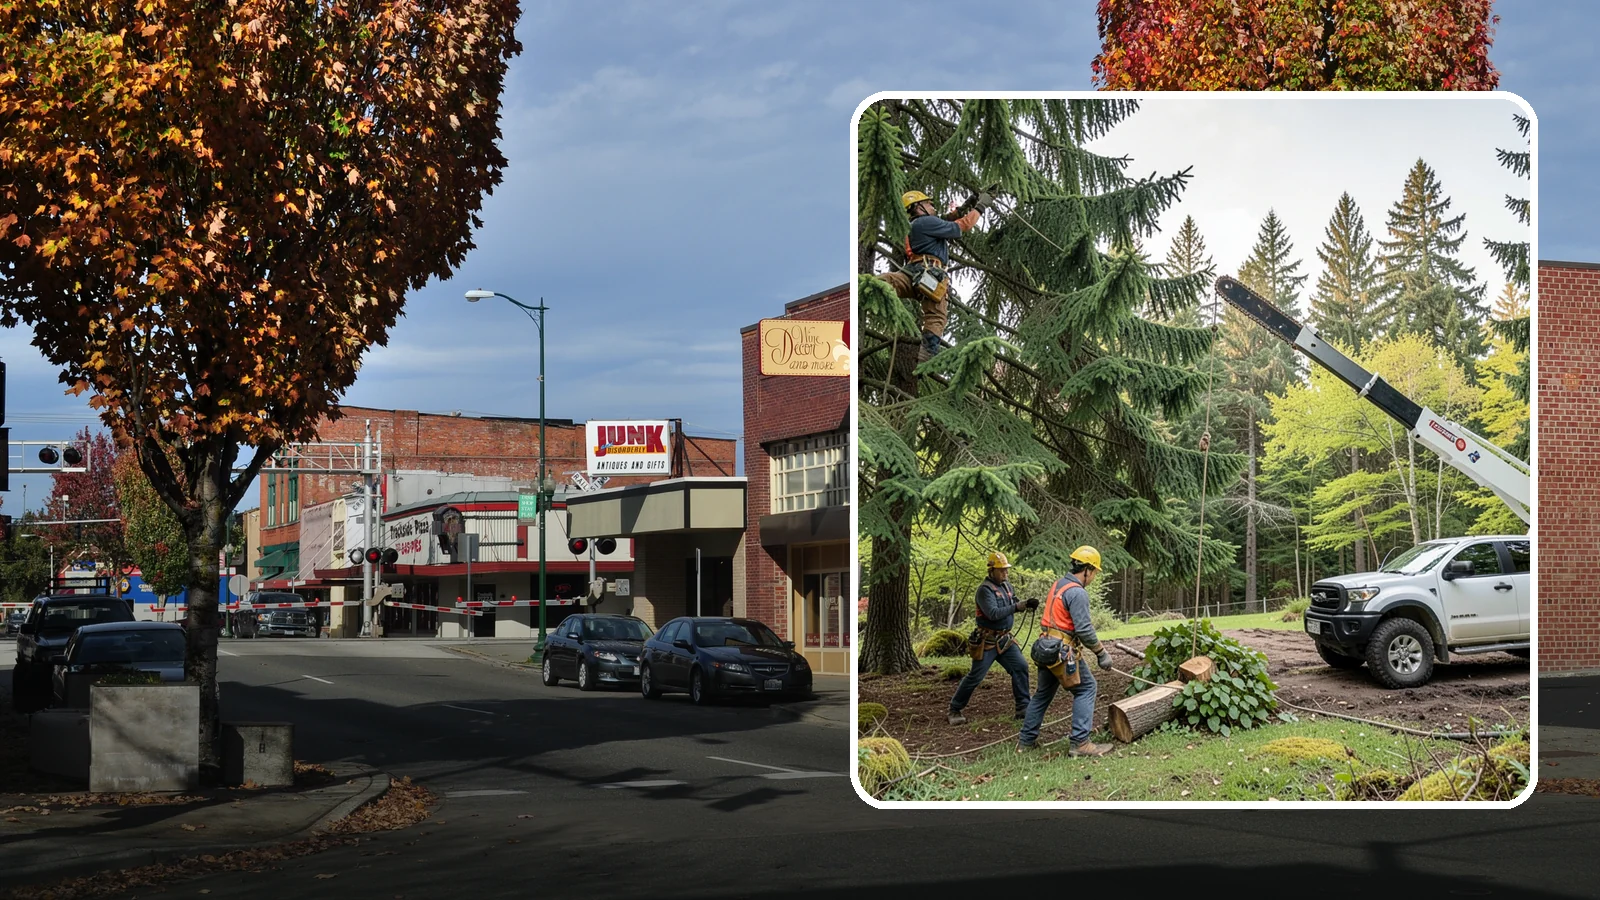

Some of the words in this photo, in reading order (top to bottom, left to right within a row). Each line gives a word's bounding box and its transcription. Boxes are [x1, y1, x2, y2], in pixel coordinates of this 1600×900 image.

[595, 425, 665, 457] JUNK
[607, 446, 646, 454] DISORDERLY
[596, 461, 628, 470] ANTIQUES
[631, 461, 644, 470] AND
[647, 460, 665, 469] GIFTS
[414, 519, 429, 534] Pizza
